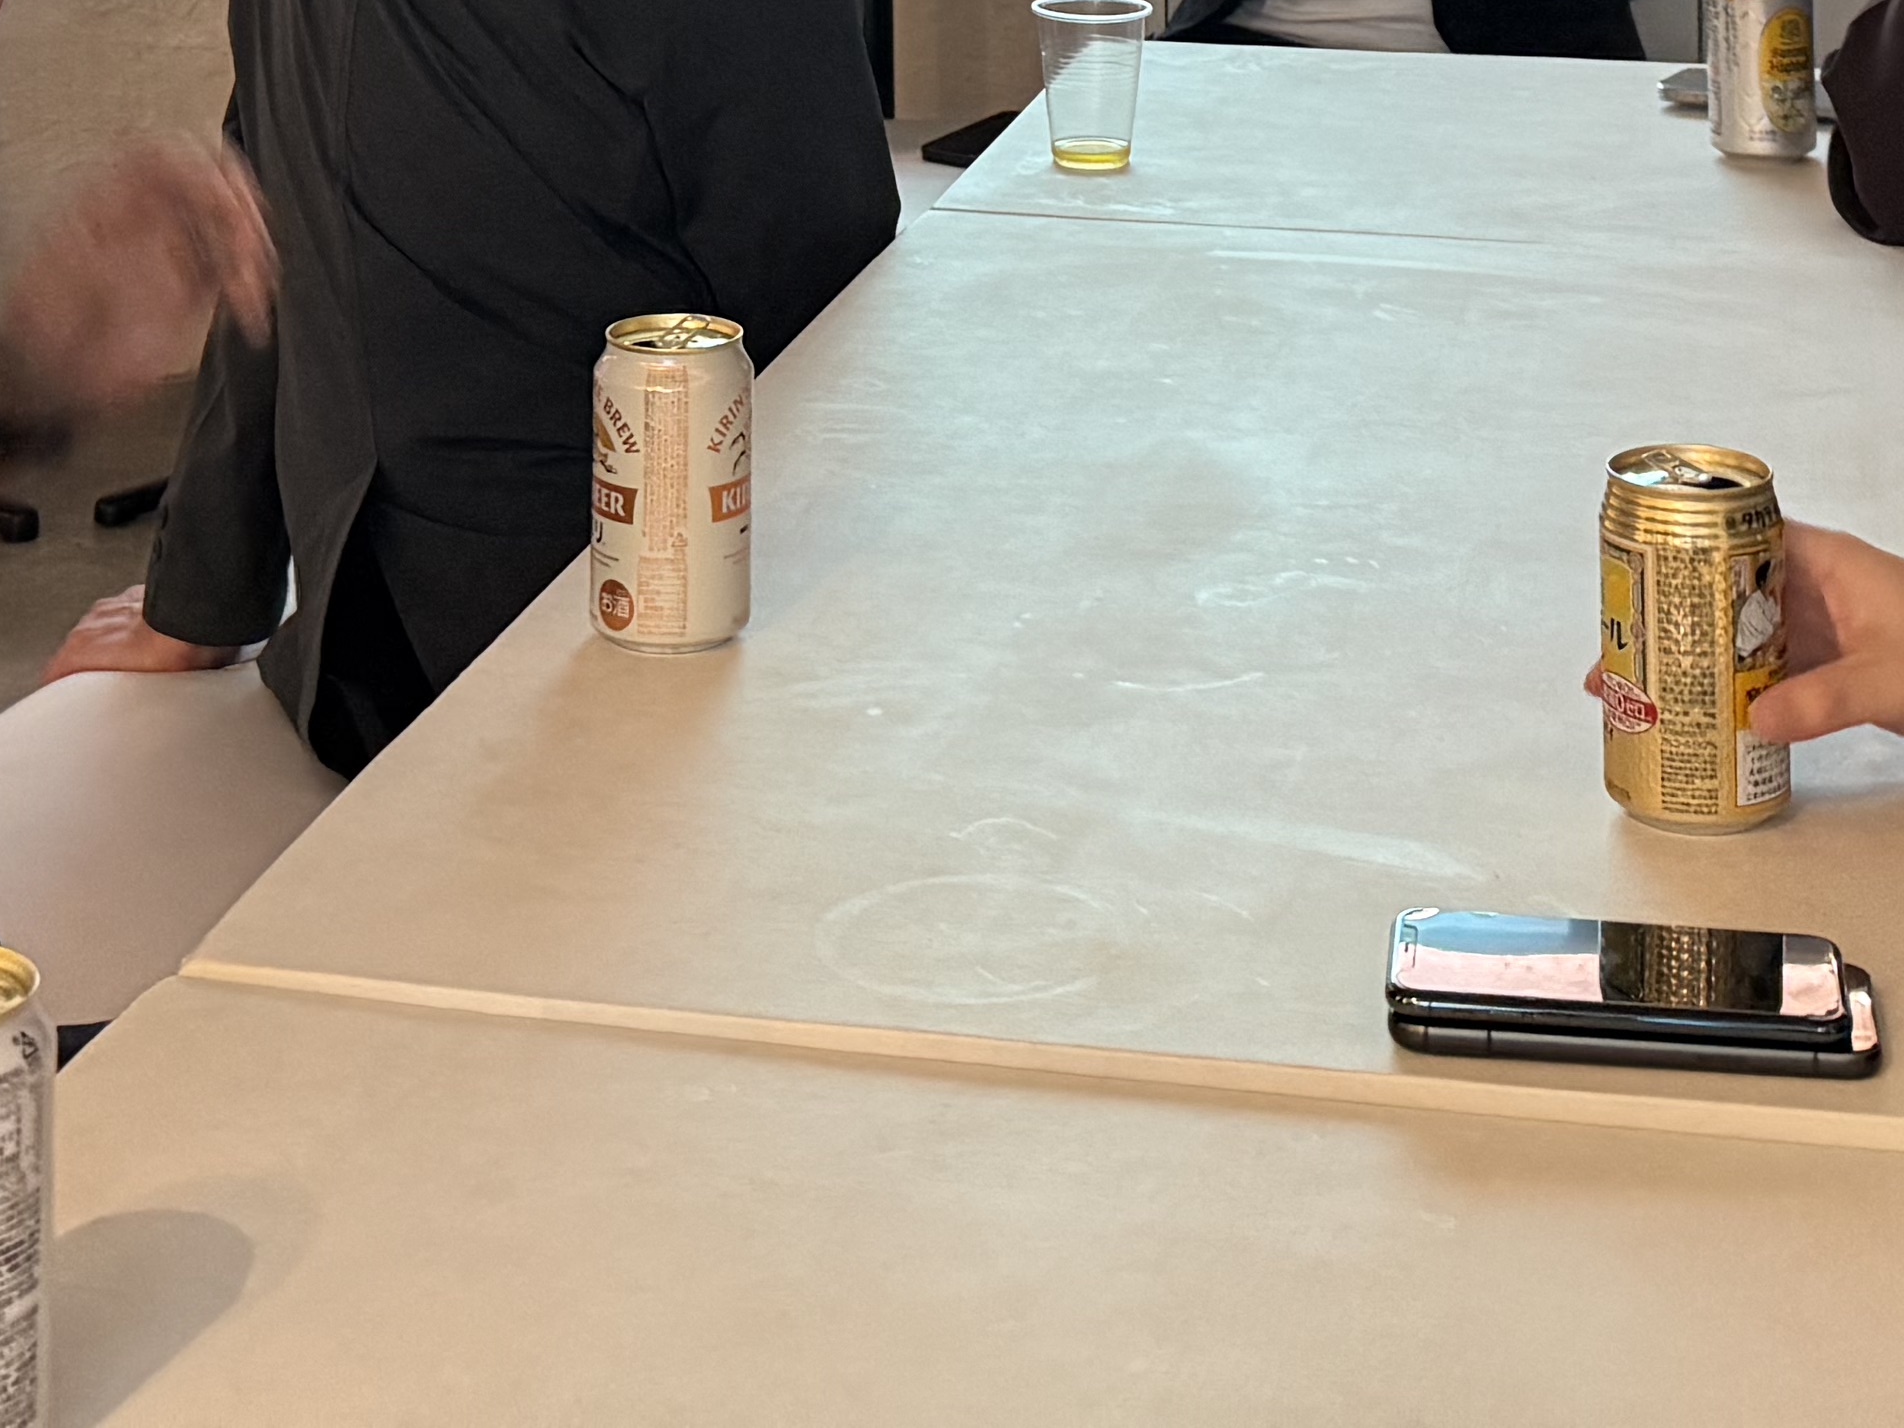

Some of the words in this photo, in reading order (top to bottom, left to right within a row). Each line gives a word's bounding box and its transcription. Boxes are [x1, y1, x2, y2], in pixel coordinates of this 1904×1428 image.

[603, 396, 641, 455] BREW
[706, 393, 746, 454] KIRIN
[593, 486, 626, 518] EER
[600, 588, 631, 619] お酒
